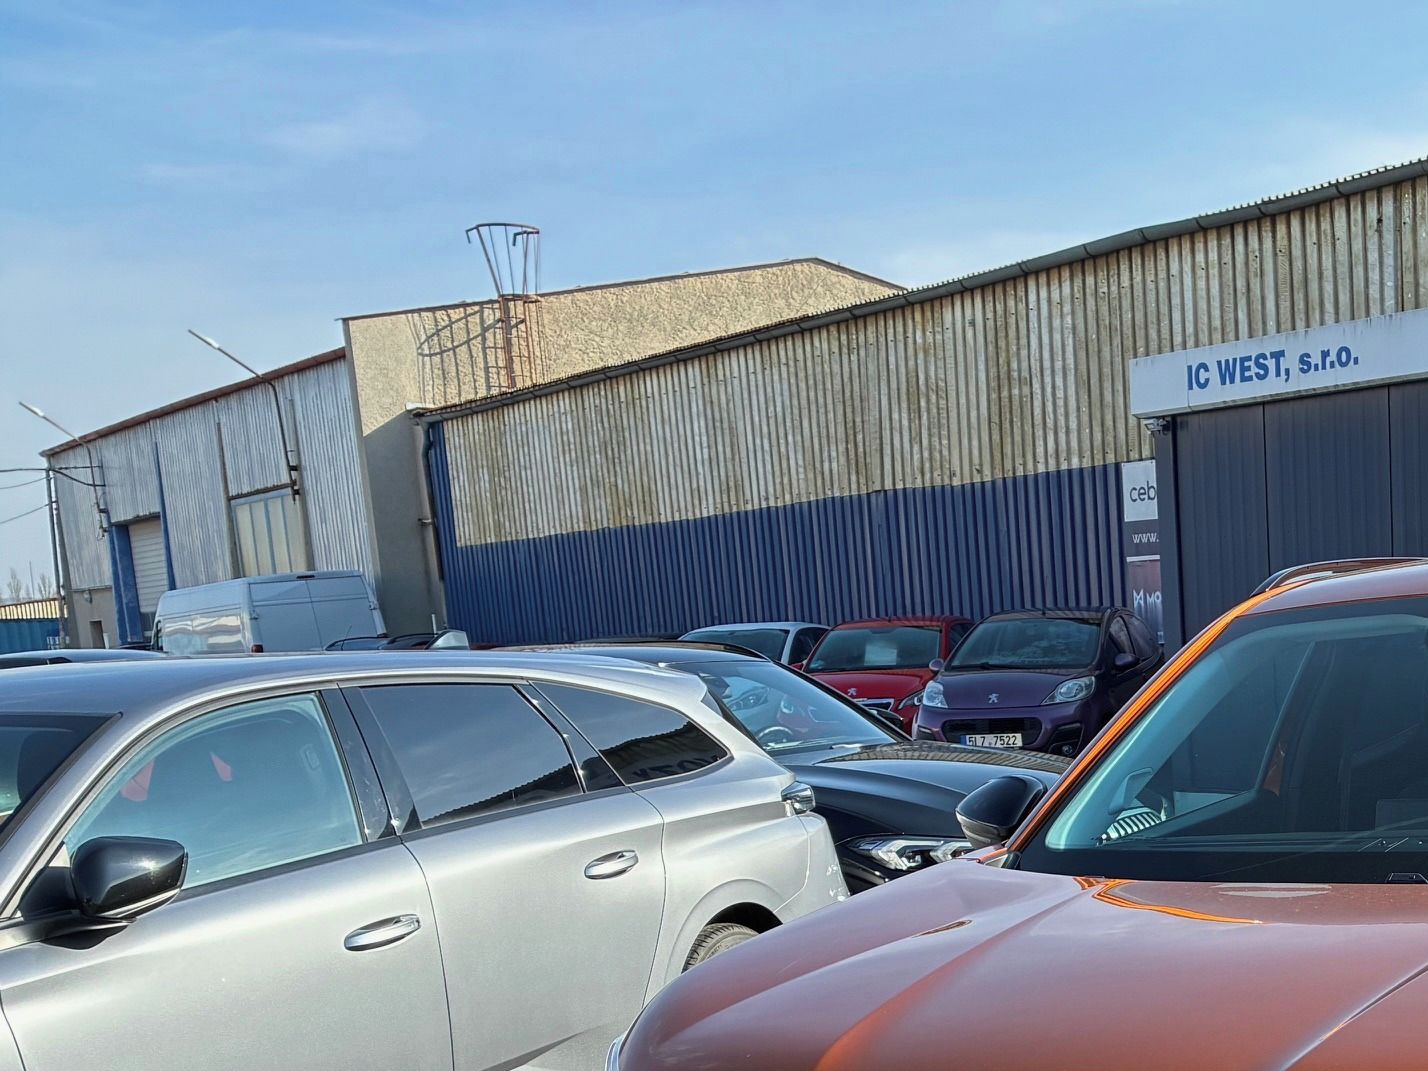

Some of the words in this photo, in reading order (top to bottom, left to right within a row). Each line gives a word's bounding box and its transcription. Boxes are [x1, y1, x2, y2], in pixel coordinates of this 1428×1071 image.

[1187, 362, 1210, 390] IC
[1216, 350, 1290, 386] WEST,
[1298, 346, 1359, 374] s.r.o.
[993, 735, 1017, 746] 7522
